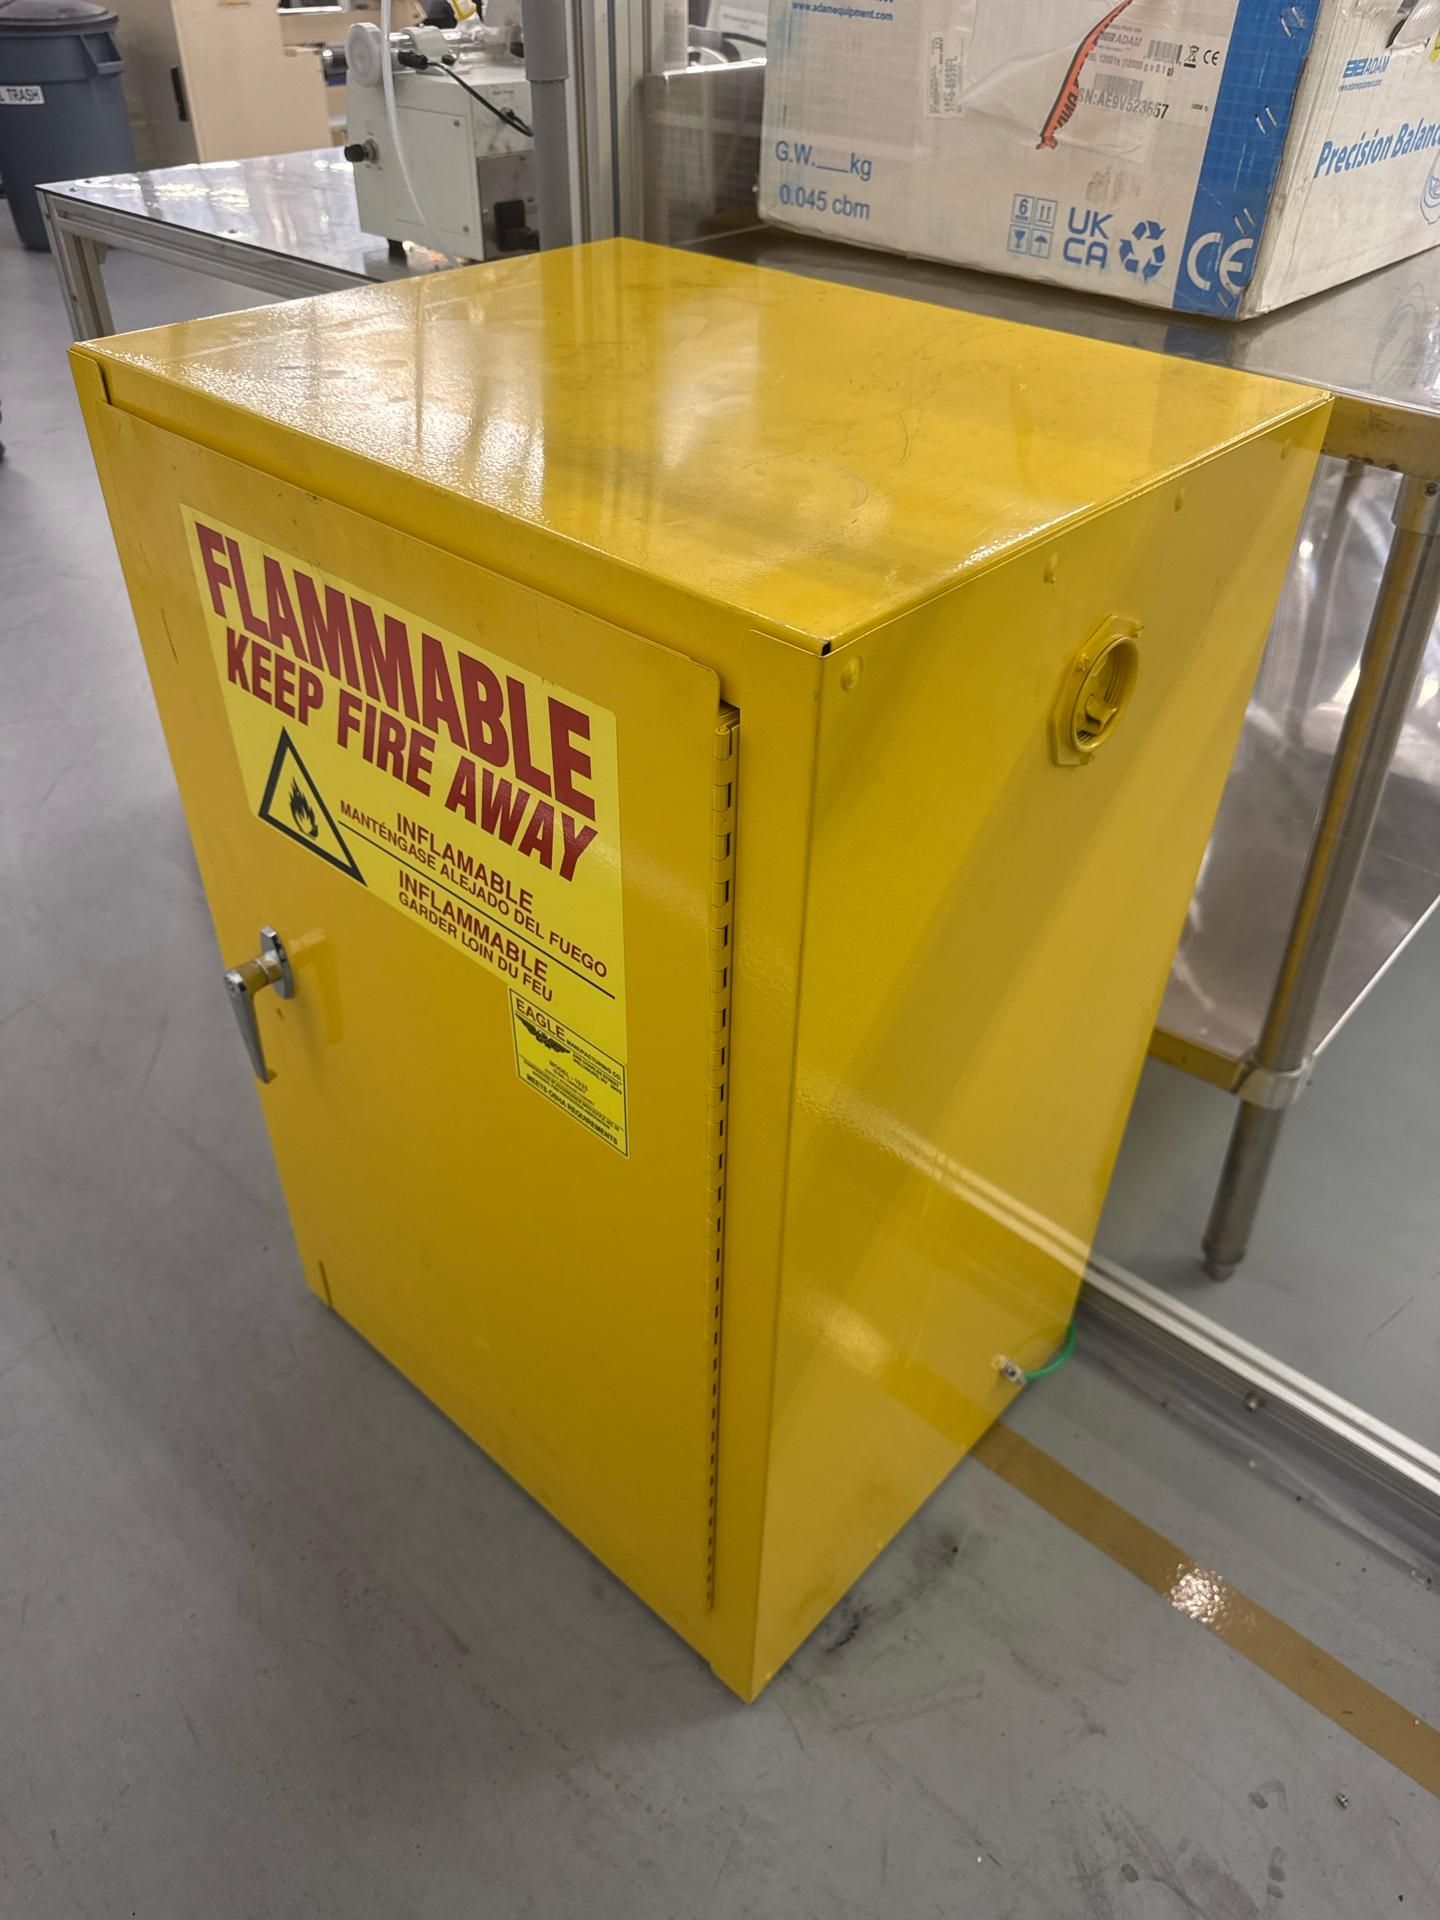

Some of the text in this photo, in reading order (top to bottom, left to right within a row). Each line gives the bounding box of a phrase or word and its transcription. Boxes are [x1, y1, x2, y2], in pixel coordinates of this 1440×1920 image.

[792, 2, 893, 20] www.adamequipment.com
[1115, 33, 1143, 48] ADAM
[1203, 50, 1220, 66] CE
[1364, 56, 1391, 75] ADAM
[775, 140, 873, 181] G.W. kg
[1313, 117, 1440, 179] Precision Balanc
[779, 184, 870, 220] 0.045 cbm
[1067, 207, 1113, 240] UK
[1063, 237, 1109, 269] CA
[1187, 232, 1254, 296] CE
[195, 521, 595, 822] FLAMMABLE
[227, 626, 598, 882] KEEP FIRE AWAY
[340, 799, 607, 978] MANTÉNGASE ALEJADO DEL FUEGO
[397, 812, 533, 914] INFLAMABLE
[399, 869, 548, 982] INFLAMMABLE
[399, 891, 552, 1002] GARDER LOIN DU FEU
[515, 997, 566, 1042] EAGLE
[526, 1073, 548, 1094] MEETS
[548, 1089, 567, 1108] OSHA
[566, 1103, 618, 1146] REQUIREMENTS
